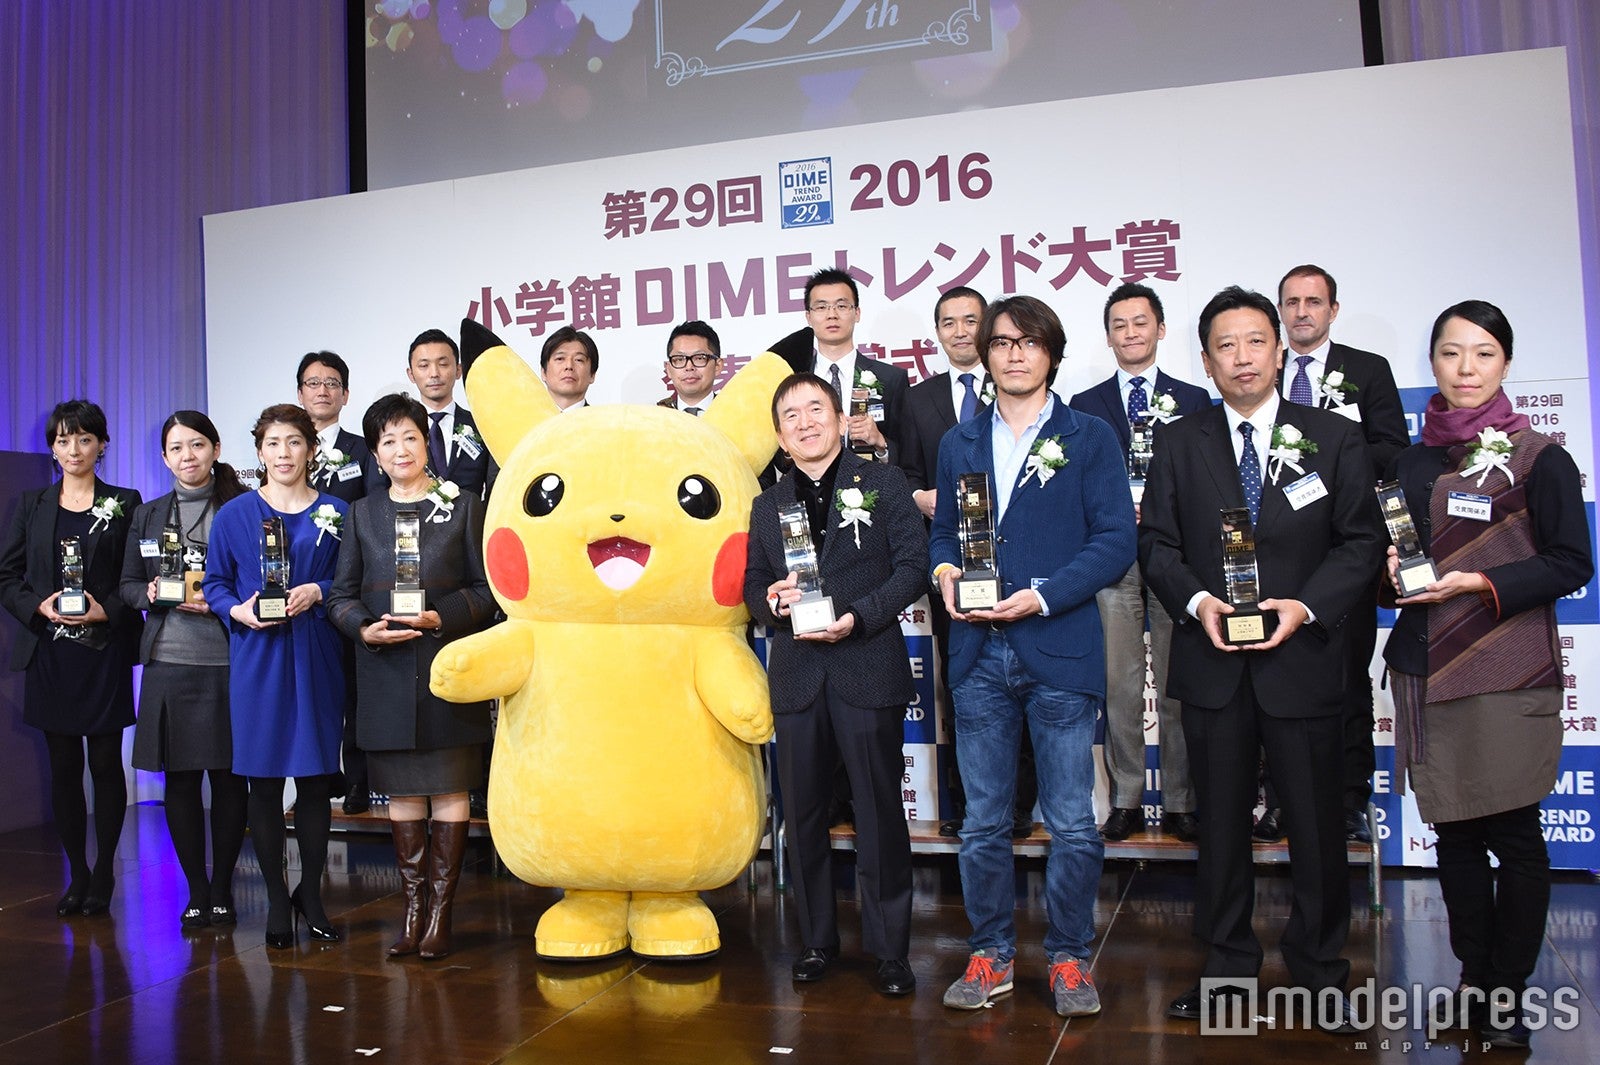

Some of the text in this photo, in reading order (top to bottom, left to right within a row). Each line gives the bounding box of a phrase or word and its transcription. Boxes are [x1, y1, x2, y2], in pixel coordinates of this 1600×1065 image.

[796, 163, 816, 172] 2016
[784, 170, 827, 188] DIME
[603, 152, 993, 240] 第29回 2016
[794, 186, 821, 195] TREND
[791, 193, 823, 203] AWARD
[1515, 394, 1563, 408] 第29回
[1531, 413, 1559, 426] 016
[235, 469, 255, 479] 29回
[1562, 716, 1597, 732] 大賞
[1550, 771, 1595, 795] ME
[1539, 809, 1592, 825] REND
[1542, 827, 1596, 842] WARD
